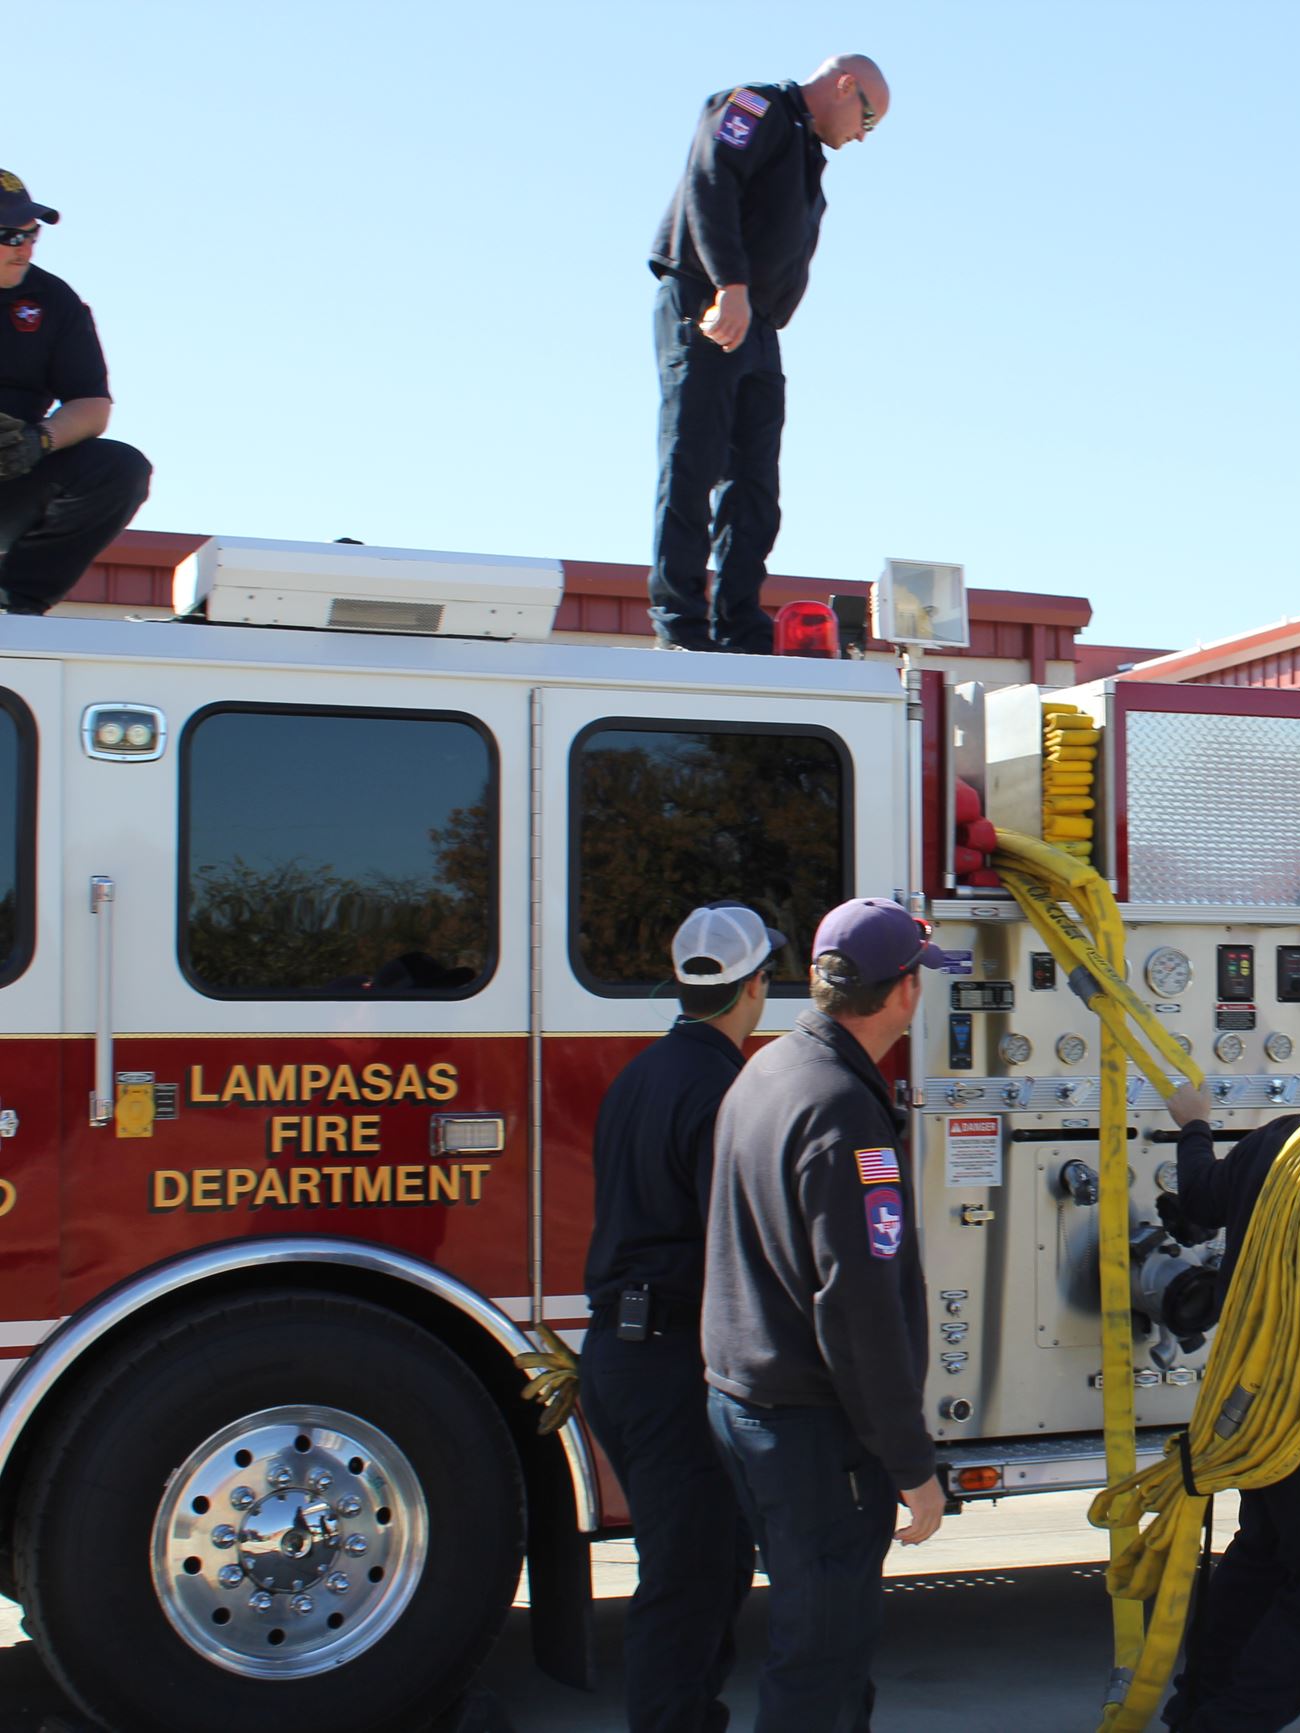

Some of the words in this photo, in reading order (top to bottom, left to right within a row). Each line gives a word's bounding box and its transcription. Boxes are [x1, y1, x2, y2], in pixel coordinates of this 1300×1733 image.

[188, 1062, 459, 1104] LAMPASAS
[269, 1114, 382, 1155] FIRE
[152, 1163, 492, 1210] DEPARTMENT
